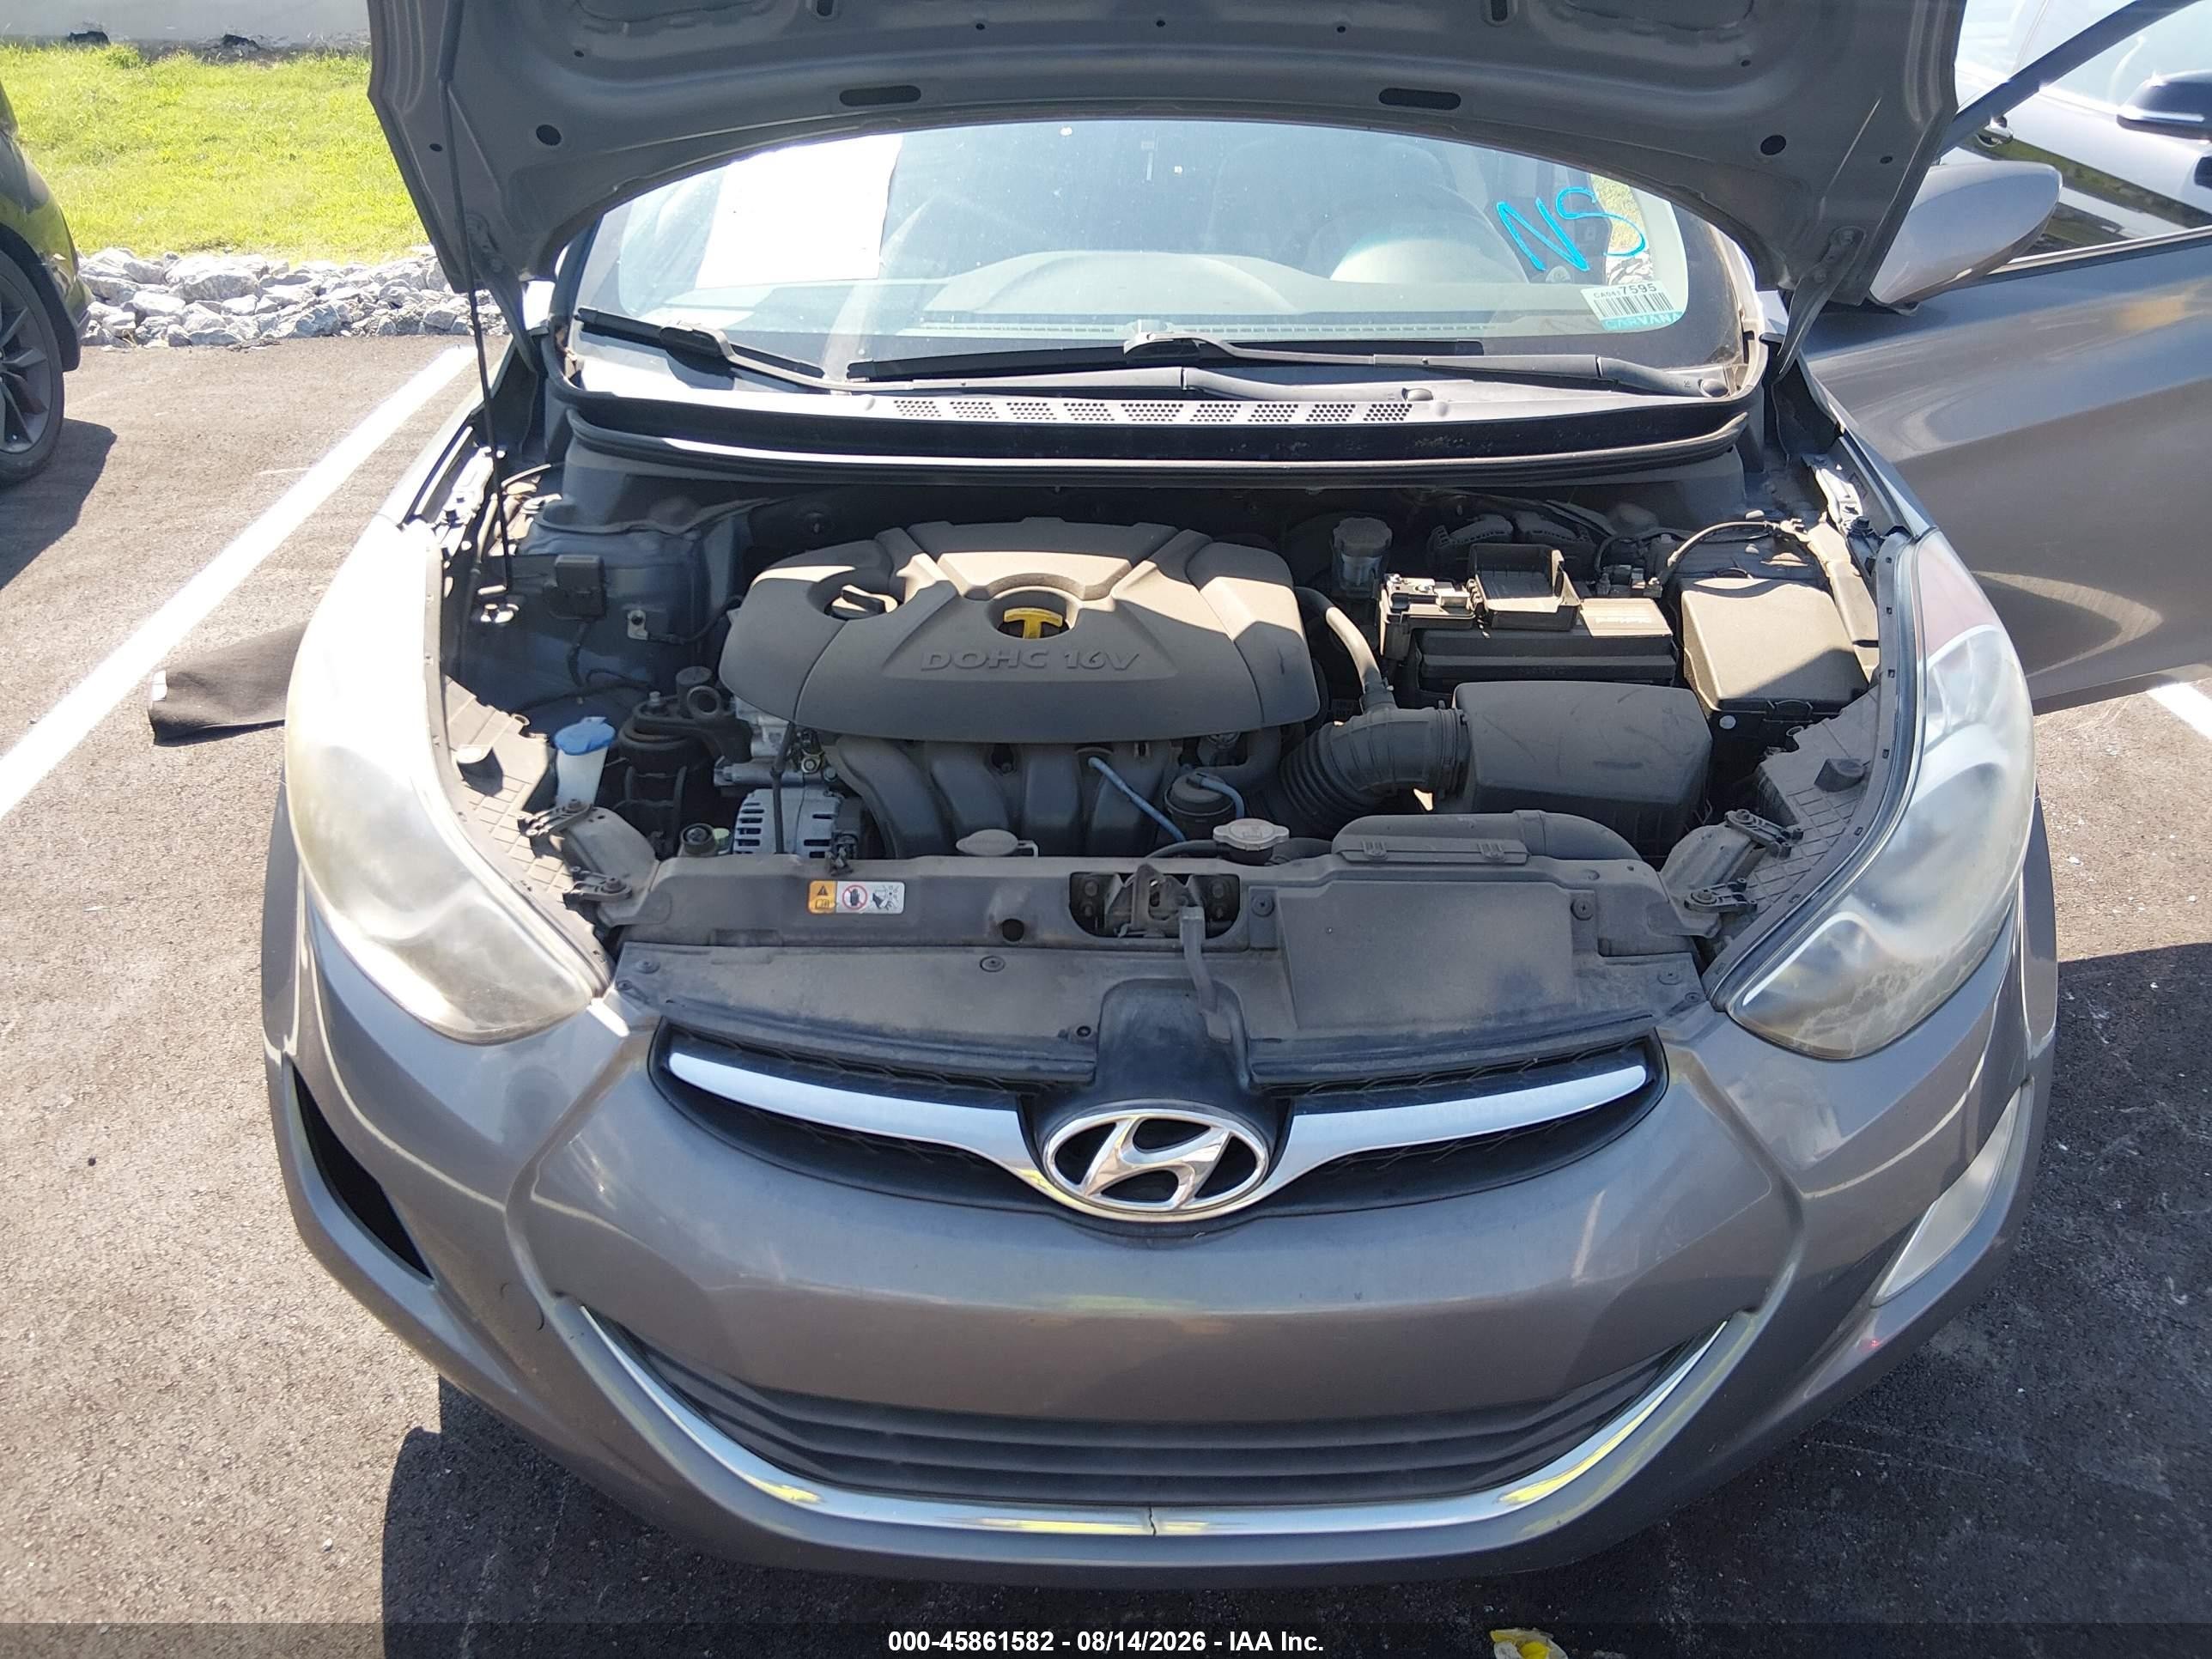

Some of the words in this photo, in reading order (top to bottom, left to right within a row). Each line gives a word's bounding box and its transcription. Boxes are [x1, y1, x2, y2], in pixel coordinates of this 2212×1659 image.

[1496, 186, 1649, 272] NS
[921, 649, 1049, 672] DOHC
[1064, 650, 1140, 672] 16V
